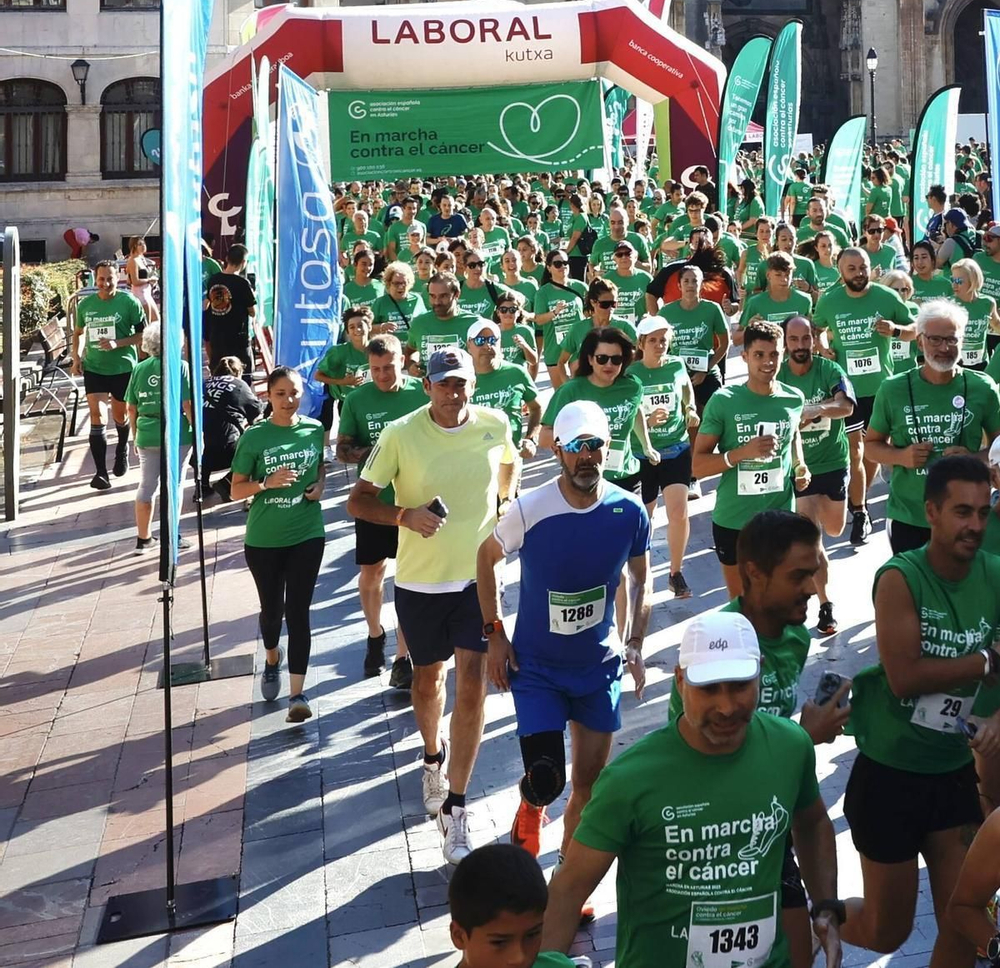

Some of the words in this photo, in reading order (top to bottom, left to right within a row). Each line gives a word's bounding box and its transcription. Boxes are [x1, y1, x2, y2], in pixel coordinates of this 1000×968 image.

[371, 16, 552, 45] LABORAL
[505, 47, 553, 62] kutxa
[628, 39, 649, 60] banca
[647, 52, 684, 80] cooperativa
[230, 83, 252, 100] banka
[780, 110, 786, 119] el
[350, 130, 370, 143] En
[375, 128, 438, 143] marcha
[350, 144, 404, 158] contra
[409, 143, 424, 156] el
[427, 141, 486, 155] cáncer
[968, 318, 987, 326] archa
[838, 326, 861, 334] contra
[847, 332, 872, 341] cáncer
[686, 356, 700, 365] 876
[966, 351, 978, 359] 185
[854, 358, 872, 369] 1076
[650, 394, 670, 406] 1345
[603, 405, 629, 413] archa
[923, 411, 963, 423] marcha
[368, 421, 380, 430] En
[608, 422, 623, 430] cer
[736, 422, 751, 433] En
[264, 455, 277, 465] En
[754, 472, 768, 485] 26
[560, 603, 594, 623] 1288
[708, 638, 728, 651] edp
[940, 698, 962, 718] 29
[665, 825, 694, 844] En
[701, 812, 775, 841] marcha
[665, 842, 731, 862] contra
[665, 863, 683, 880] el
[689, 860, 759, 881] cáncer
[709, 924, 759, 954] 1343
